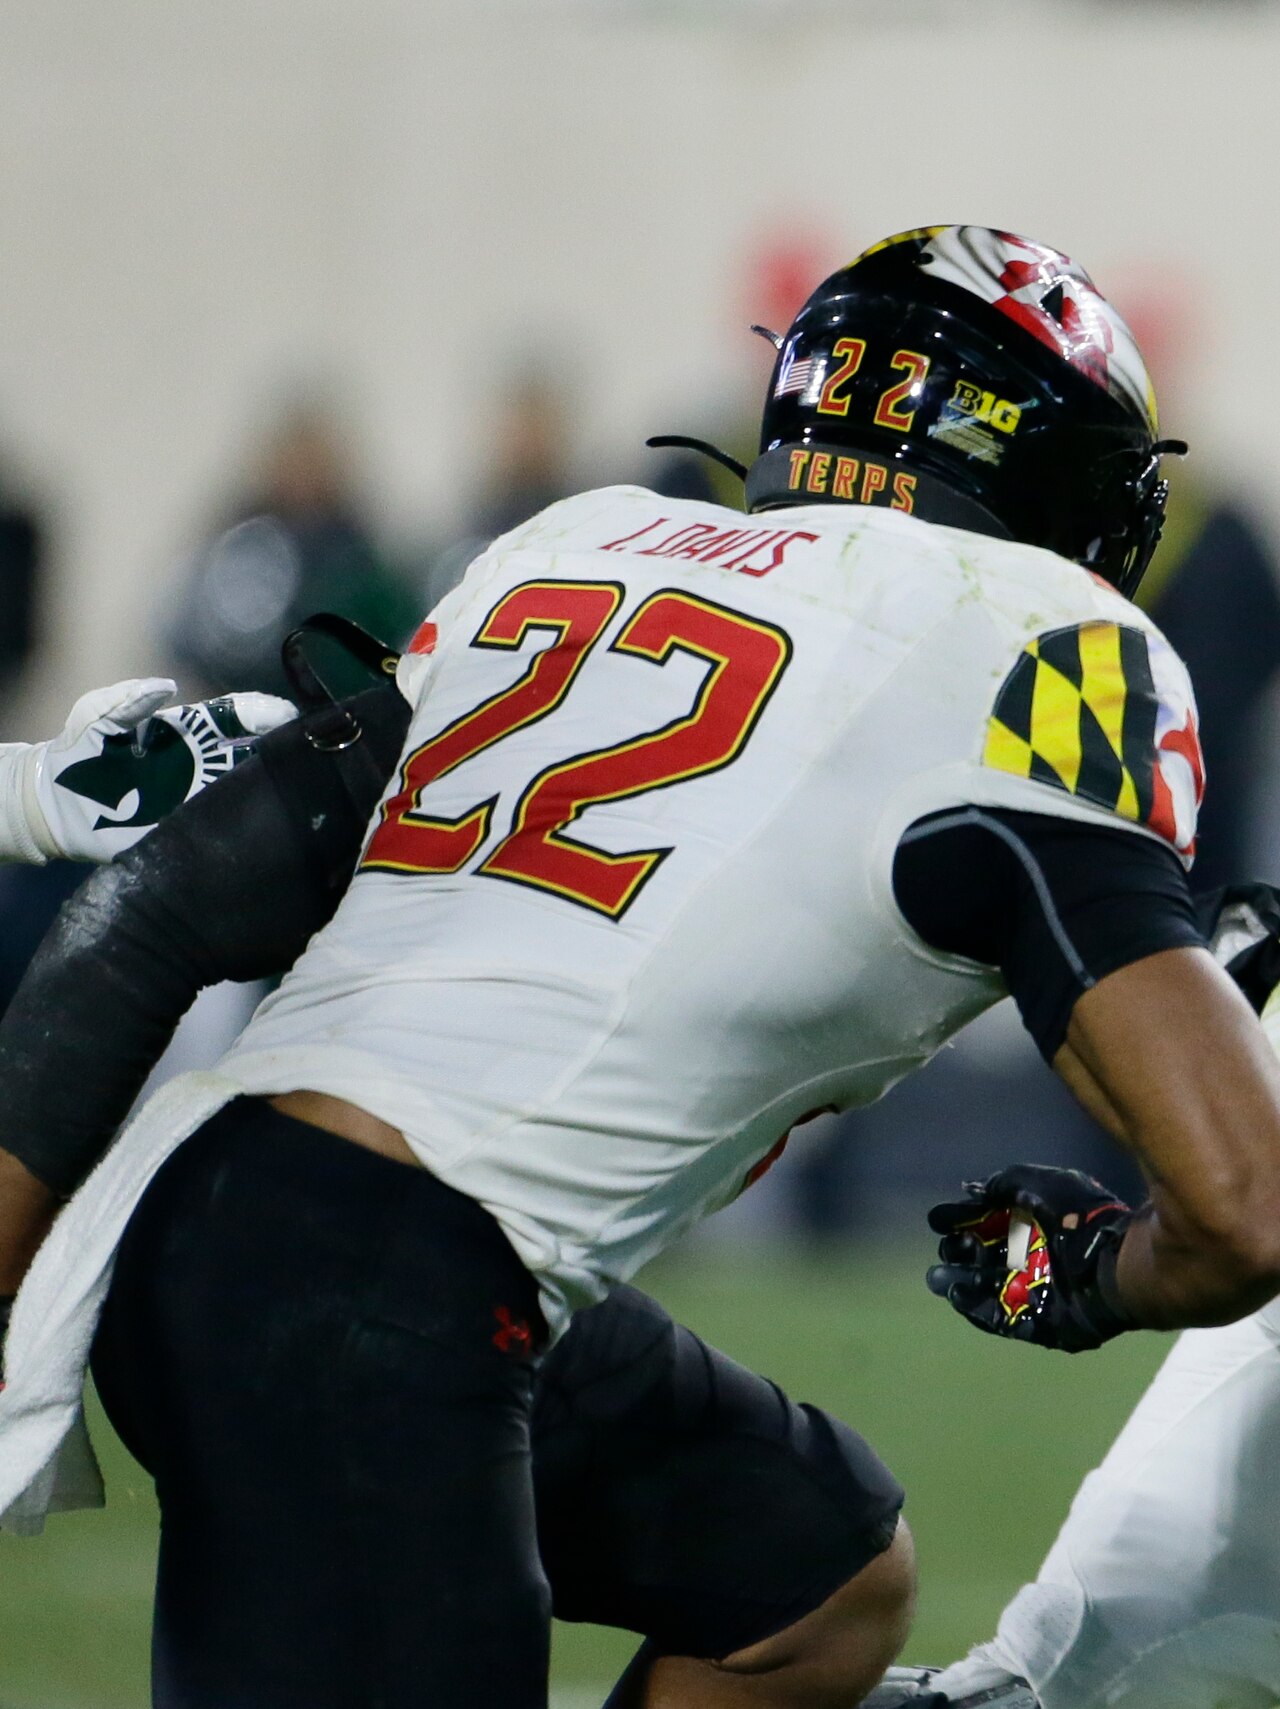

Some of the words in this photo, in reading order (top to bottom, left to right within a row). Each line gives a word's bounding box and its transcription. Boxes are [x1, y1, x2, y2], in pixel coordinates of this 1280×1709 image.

[789, 450, 917, 514] TERPS
[635, 523, 820, 577] DAVIS
[357, 580, 793, 923] 22
